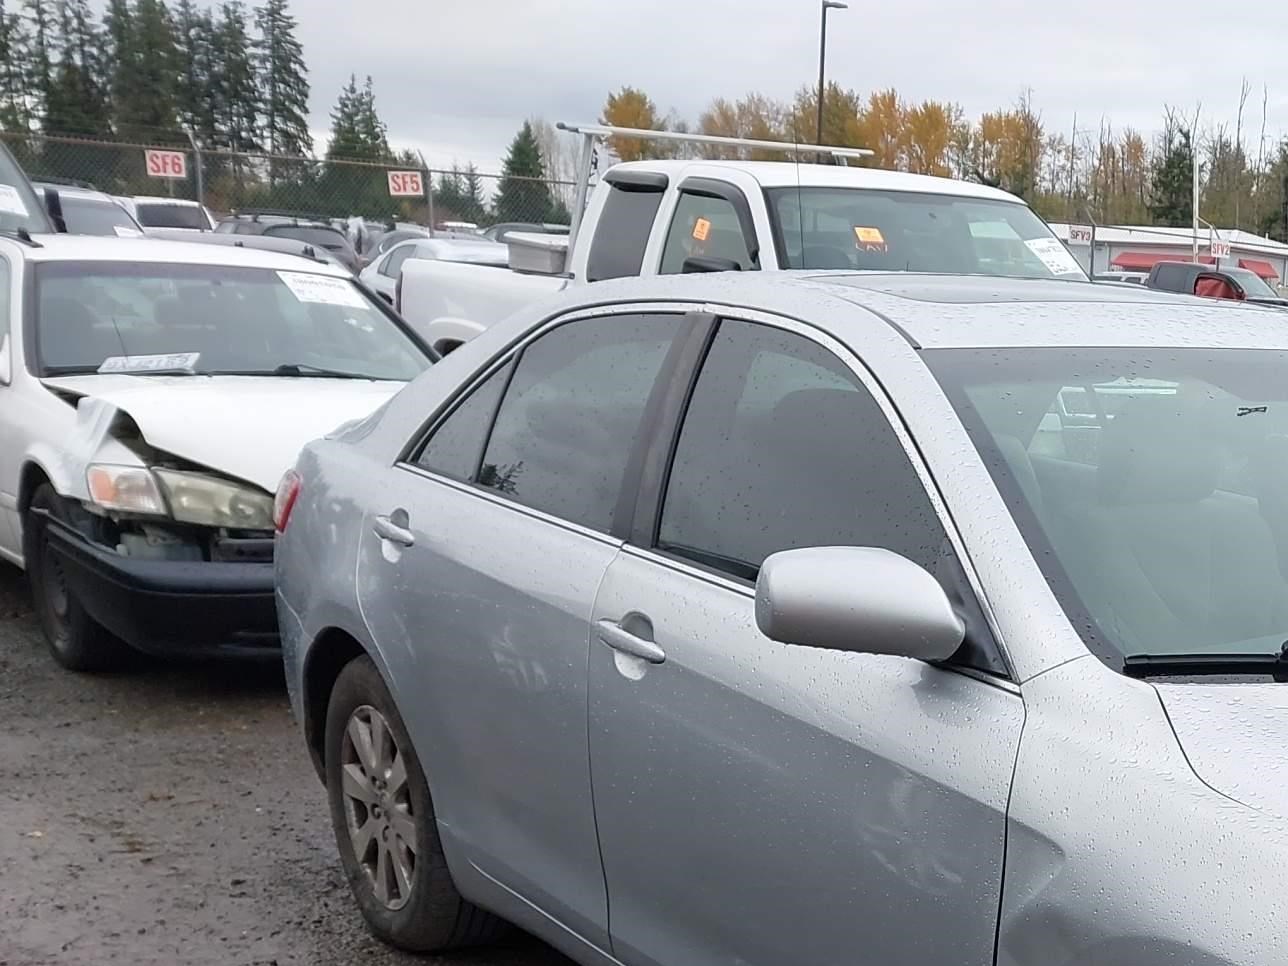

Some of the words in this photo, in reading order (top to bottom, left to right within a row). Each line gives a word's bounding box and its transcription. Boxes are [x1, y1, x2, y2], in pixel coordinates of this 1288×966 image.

[149, 153, 183, 174] SF6
[391, 173, 421, 192] SF5
[1070, 230, 1091, 242] SFV3
[1212, 243, 1230, 256] SFV2
